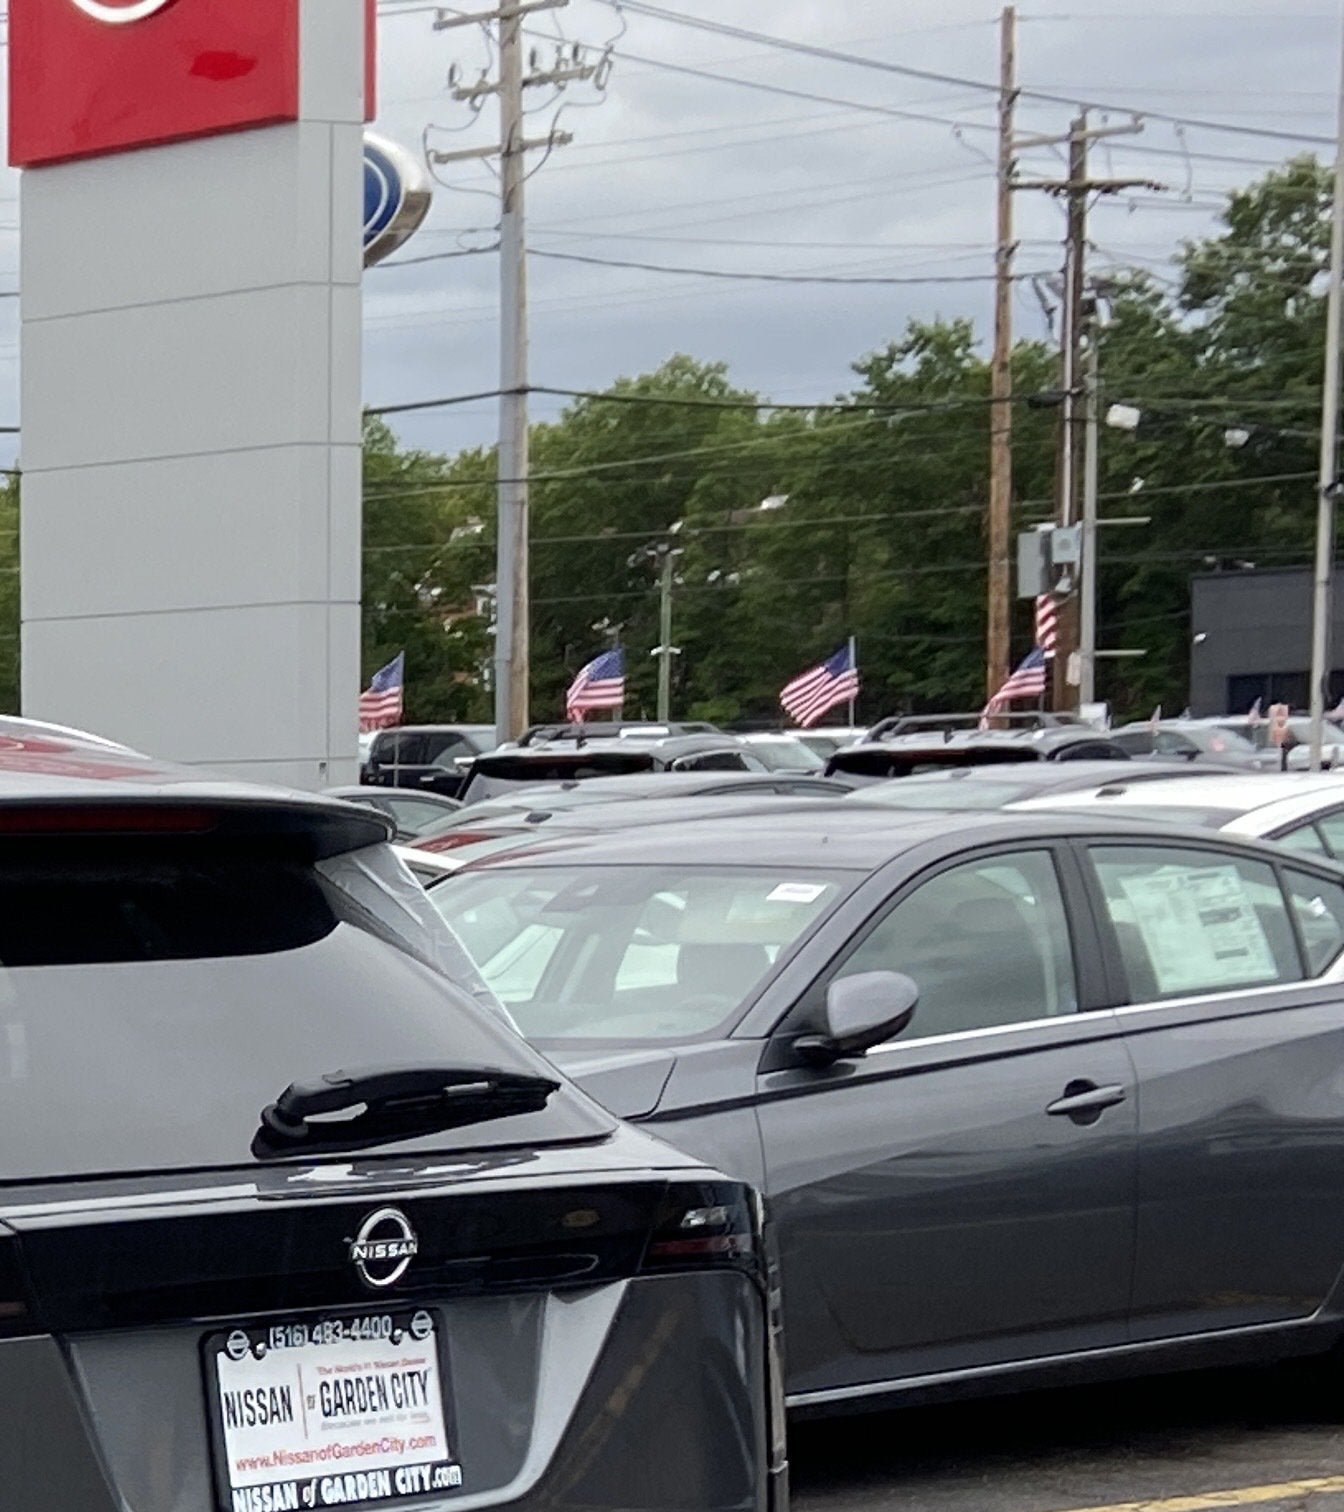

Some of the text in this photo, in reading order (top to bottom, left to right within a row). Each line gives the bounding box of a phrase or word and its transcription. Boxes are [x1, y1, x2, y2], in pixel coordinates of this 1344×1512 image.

[352, 1241, 418, 1260] NISSAN
[269, 1315, 392, 1348] (516) 483-4400
[223, 1384, 294, 1430] NISSAN
[319, 1374, 389, 1418] GARDEN
[390, 1369, 429, 1409] CITY
[302, 1479, 317, 1508] of
[320, 1470, 392, 1505] GARDEN
